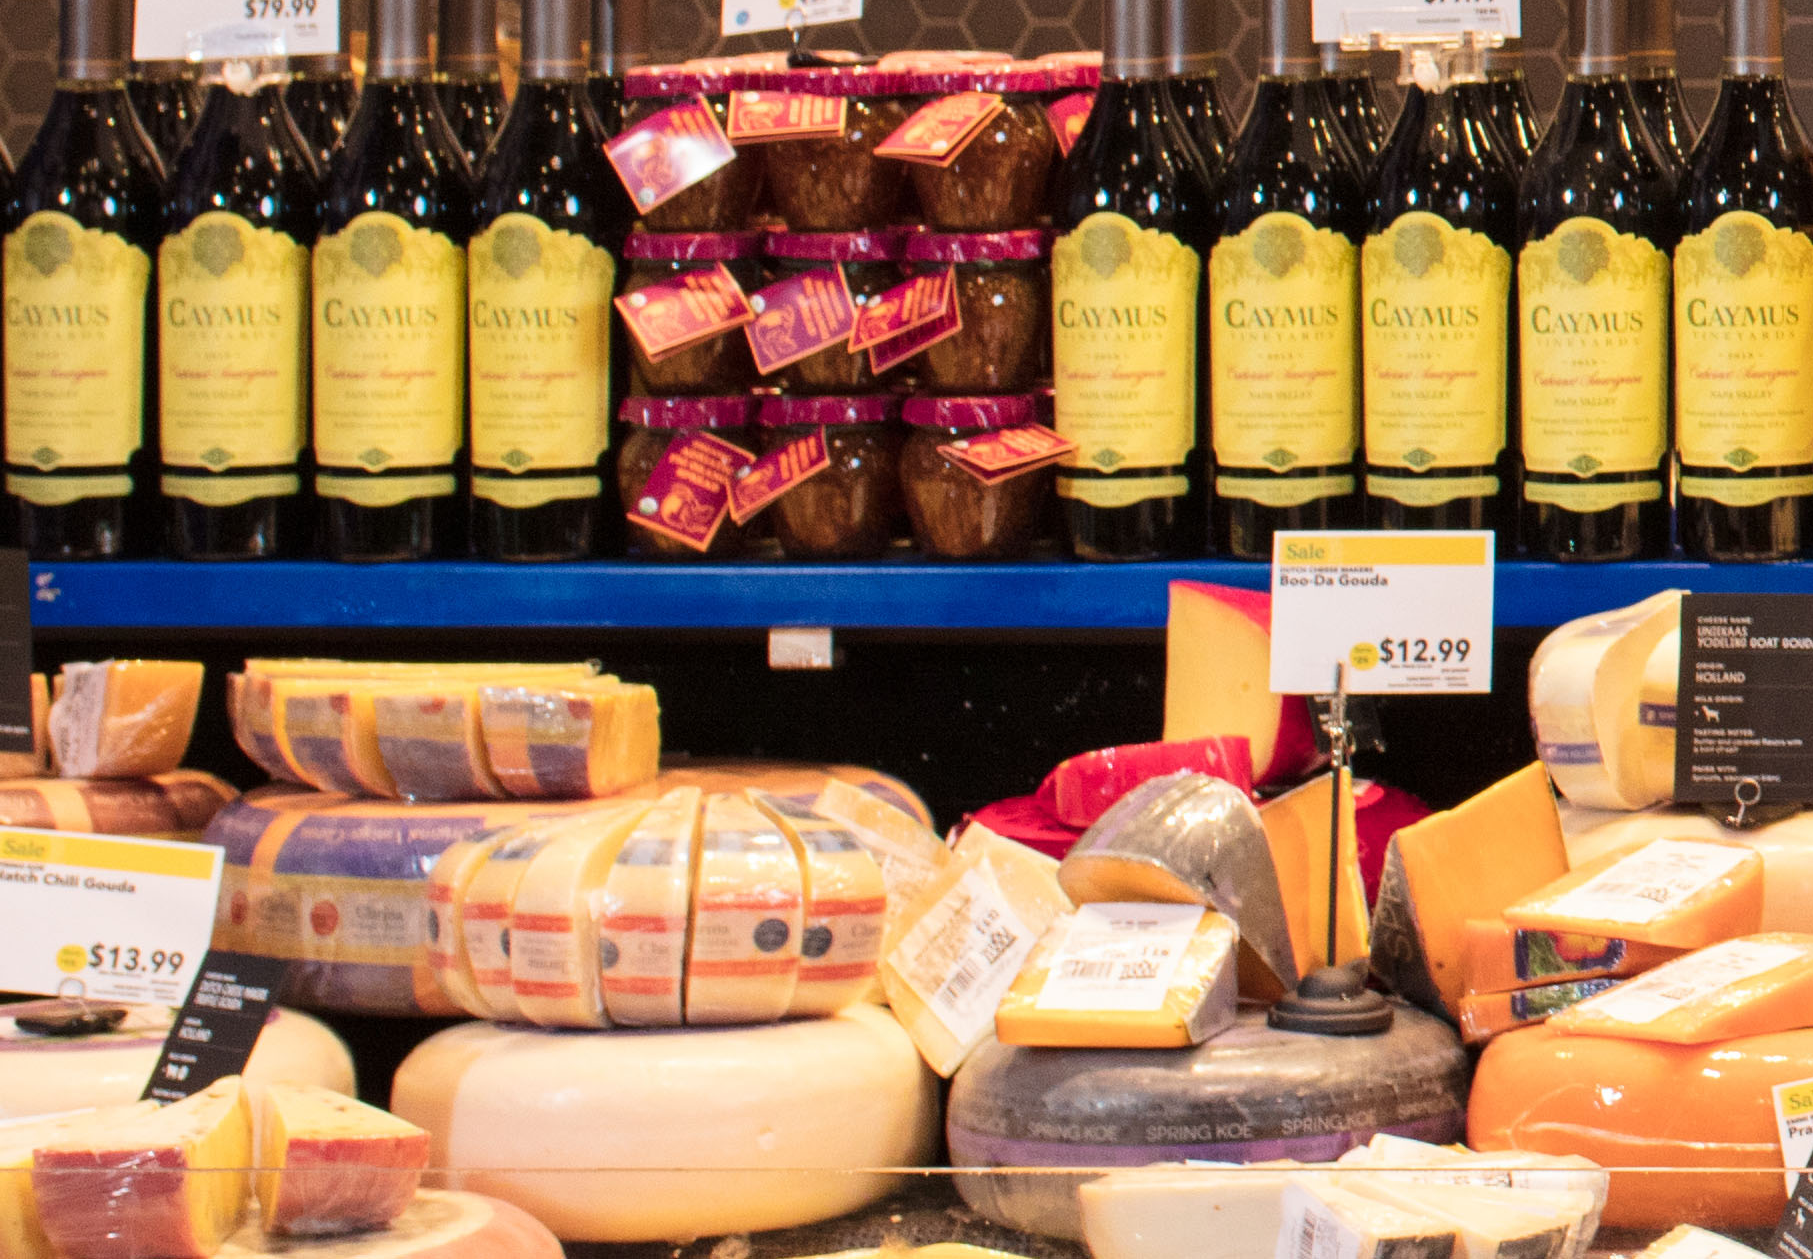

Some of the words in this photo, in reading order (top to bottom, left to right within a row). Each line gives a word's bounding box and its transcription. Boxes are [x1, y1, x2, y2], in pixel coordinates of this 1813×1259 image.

[167, 297, 281, 328] CAYMUS
[323, 297, 438, 328] CAYMUS
[472, 298, 579, 328] CAYMUS
[1057, 298, 1167, 330] CAYMUS
[1223, 298, 1339, 329] CAYMUS
[1371, 298, 1480, 329] CAYMUS
[1531, 303, 1644, 335] CAYMUS
[1687, 297, 1800, 328] CAYMUS
[1286, 543, 1325, 559] Sale
[1280, 574, 1334, 586] Boo-Da
[1339, 573, 1389, 586] Gouda
[1379, 637, 1471, 664] $12.99
[1695, 672, 1746, 684] HOLLAND
[4, 839, 44, 857] Sale
[43, 872, 79, 888] Chili
[84, 876, 136, 894] Gouda
[88, 942, 184, 975] $13.99
